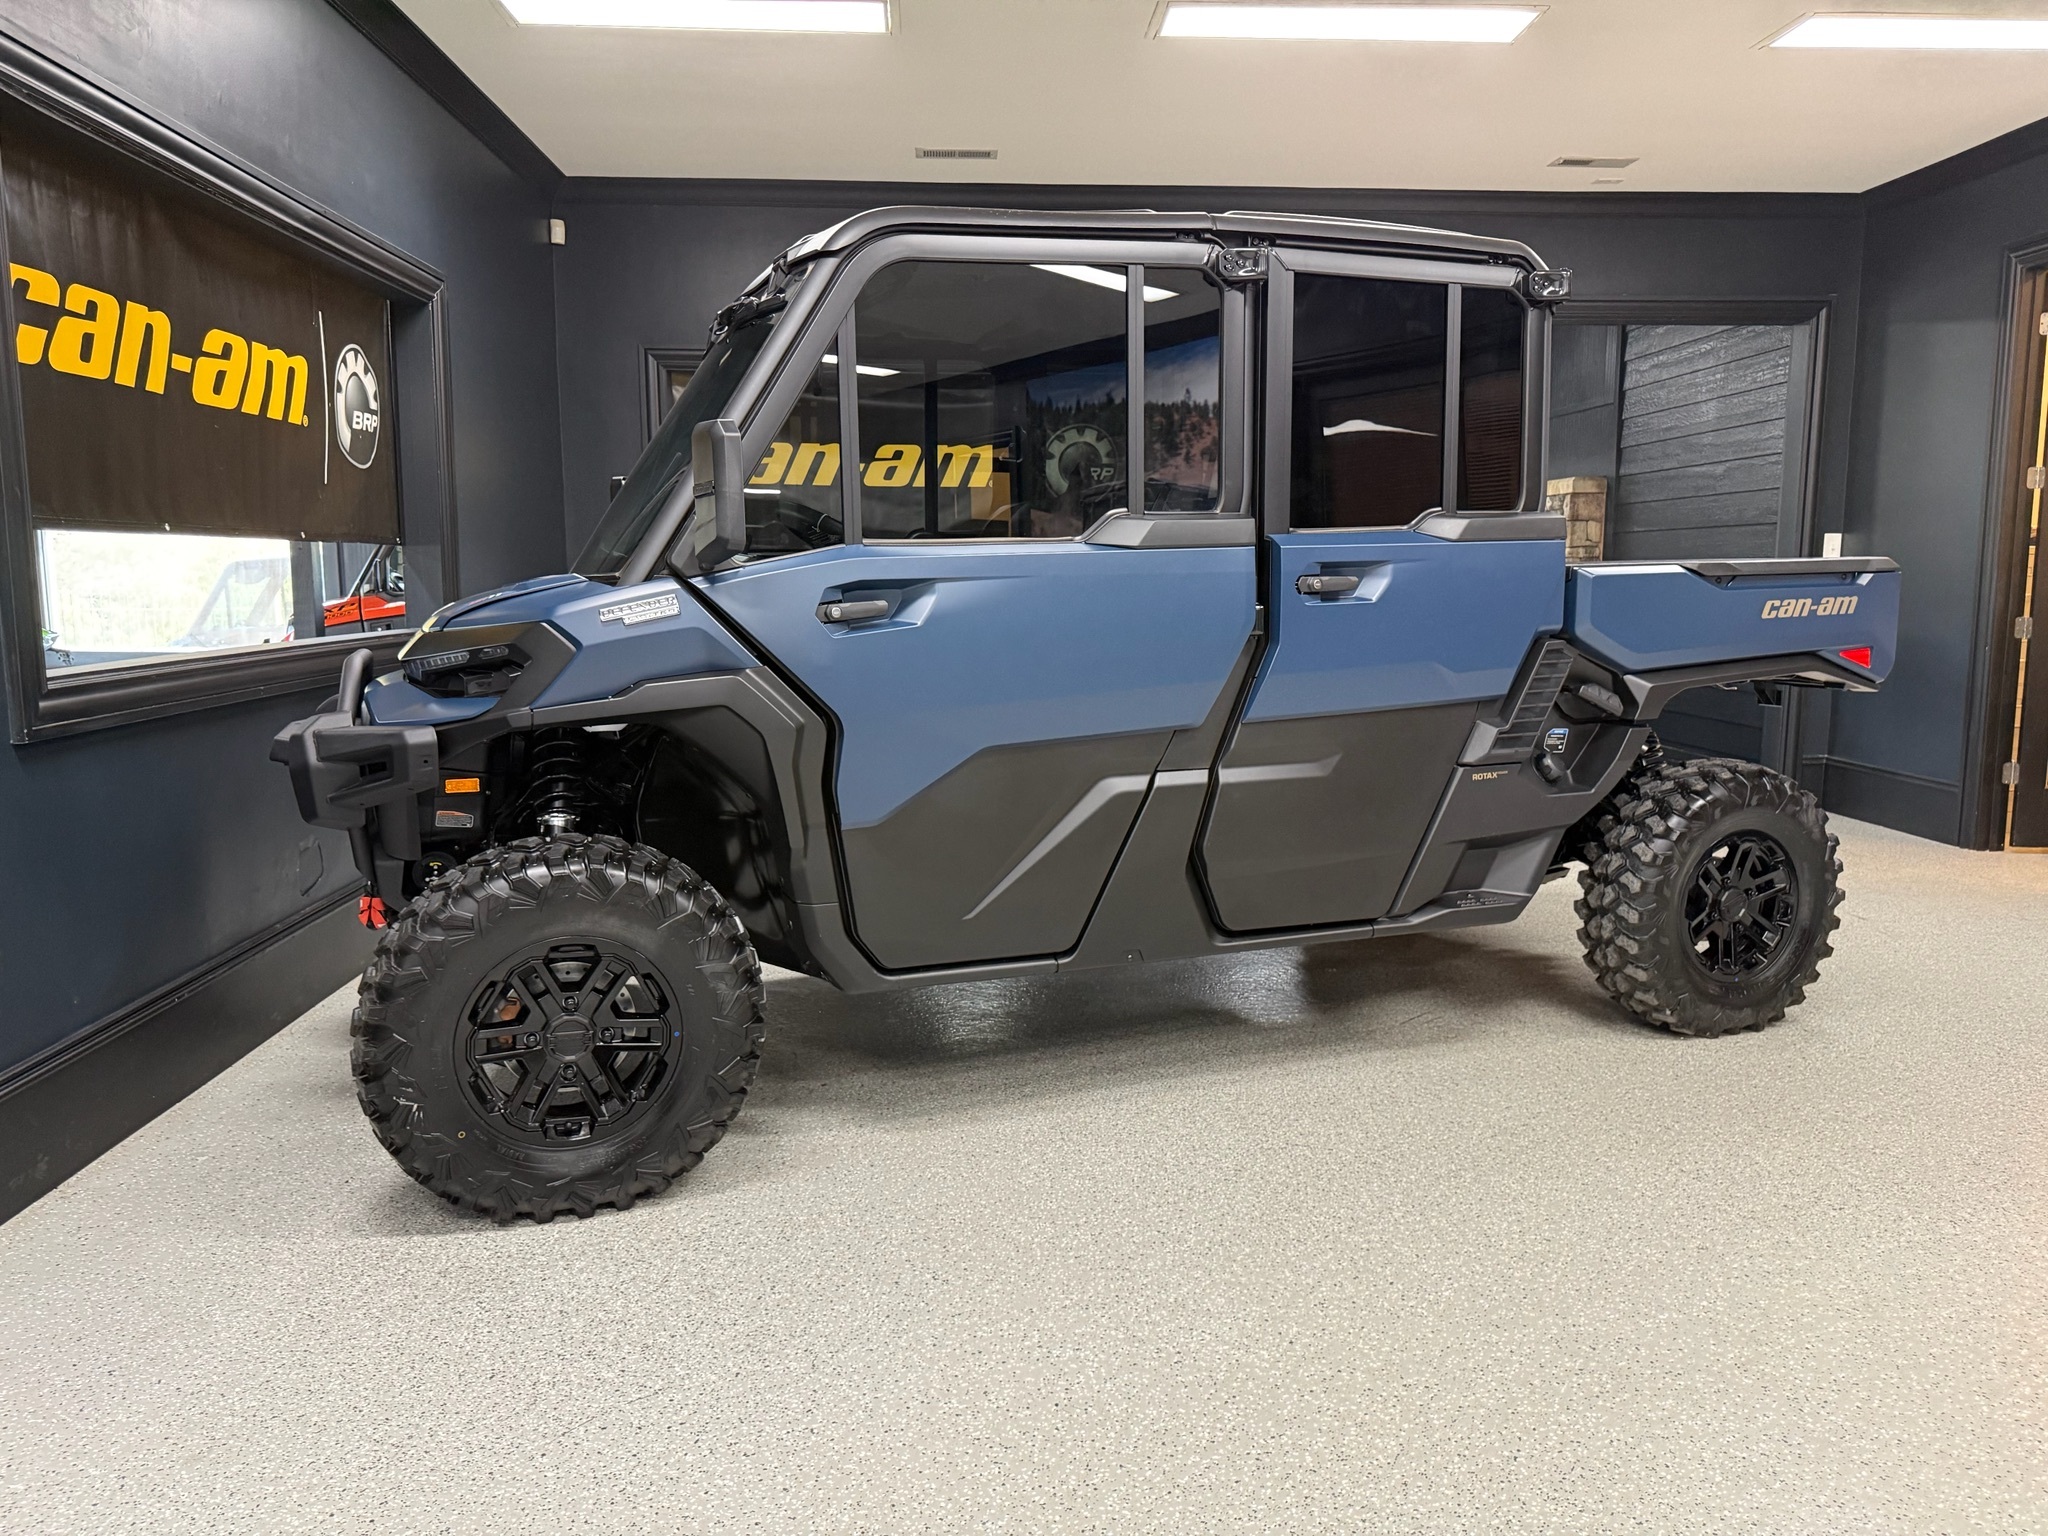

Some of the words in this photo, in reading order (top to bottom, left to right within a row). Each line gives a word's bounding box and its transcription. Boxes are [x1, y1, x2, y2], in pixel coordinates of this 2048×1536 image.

[352, 410, 378, 432] BRP
[601, 596, 676, 618] DEFENDER
[1761, 595, 1859, 619] can-am
[1472, 771, 1498, 781] ROTAX
